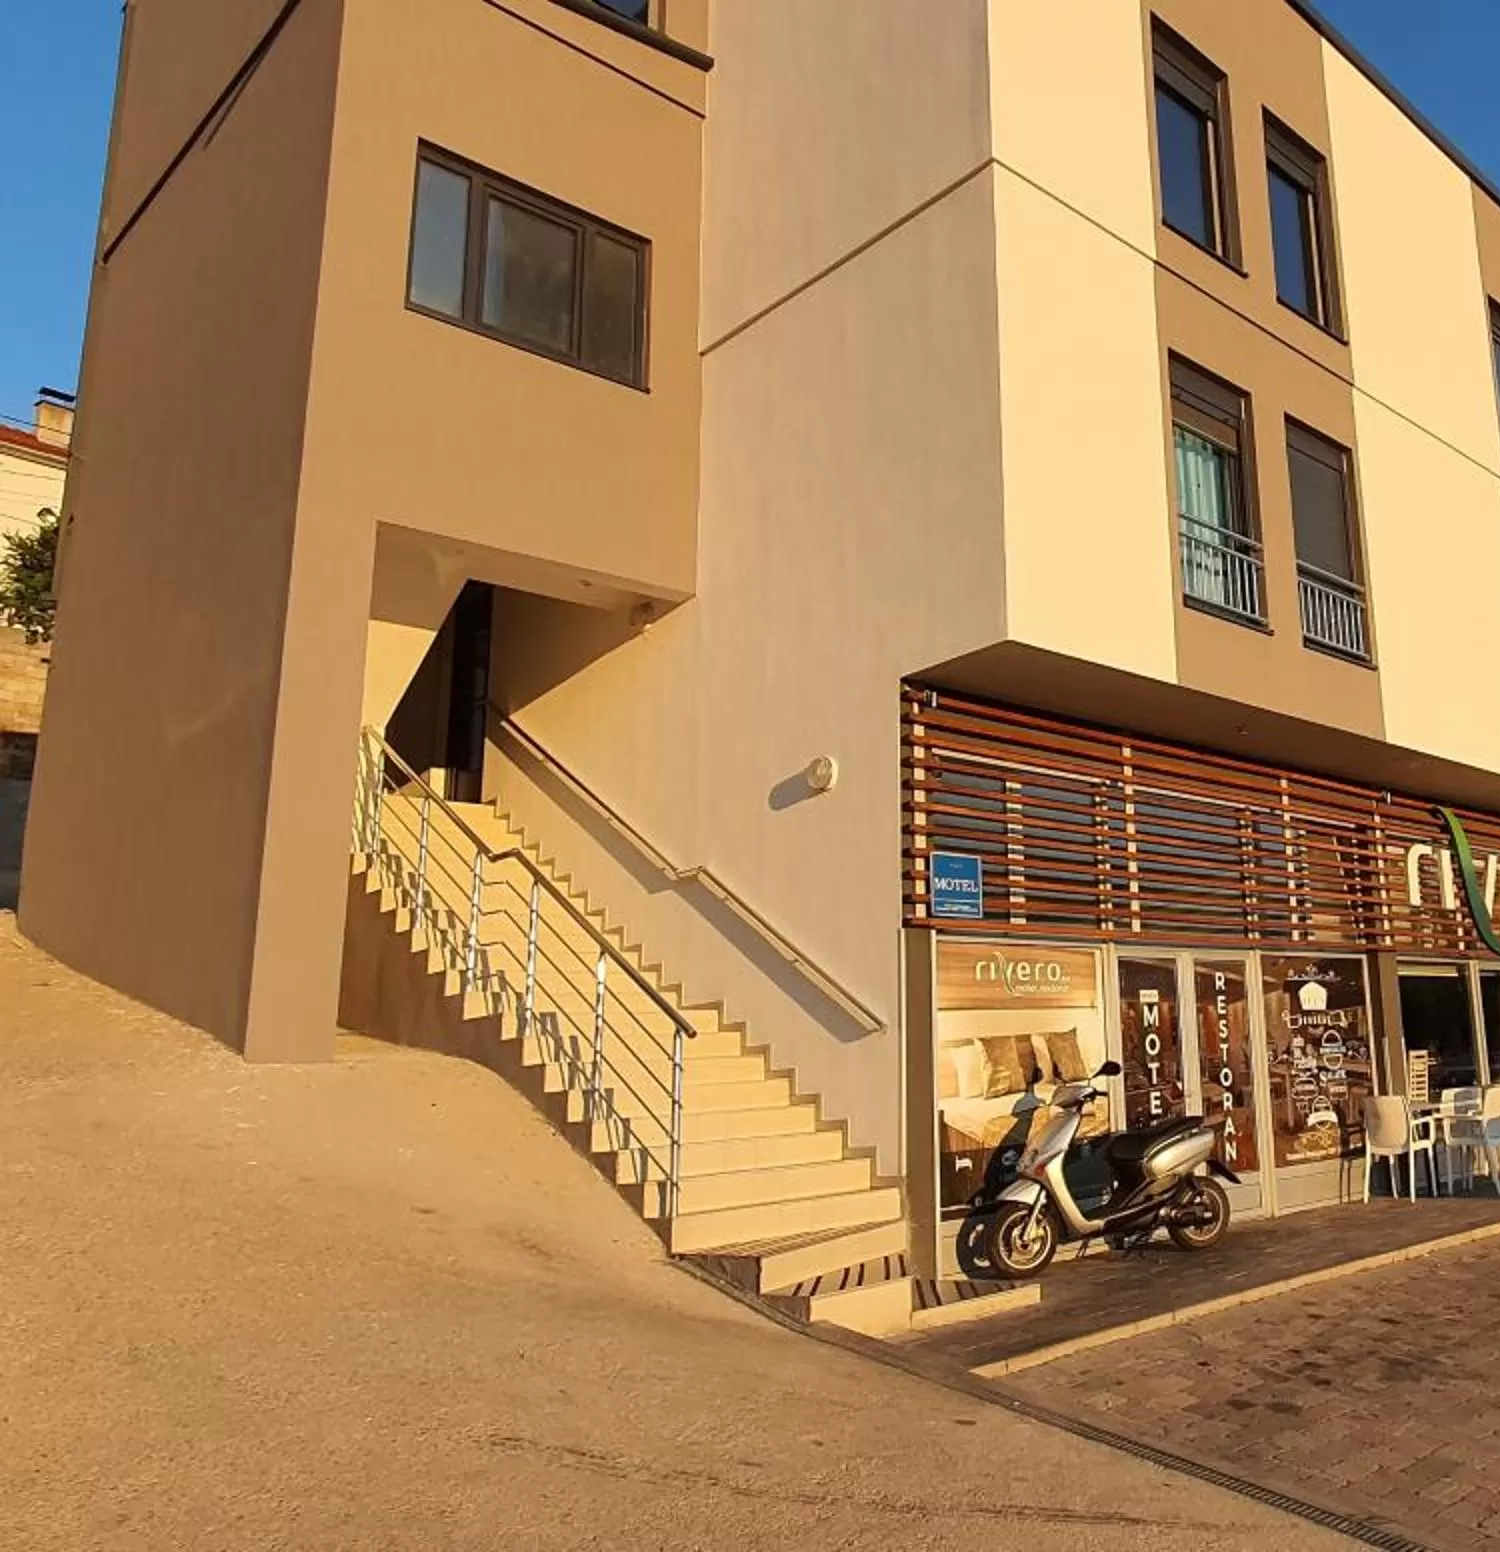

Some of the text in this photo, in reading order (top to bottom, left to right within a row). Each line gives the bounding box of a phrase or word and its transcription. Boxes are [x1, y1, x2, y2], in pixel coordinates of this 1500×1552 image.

[933, 877, 979, 892] MOTEL
[976, 958, 1061, 983] rivero
[1143, 1005, 1163, 1119] MOTE
[1215, 972, 1237, 1161] RESTORAN
